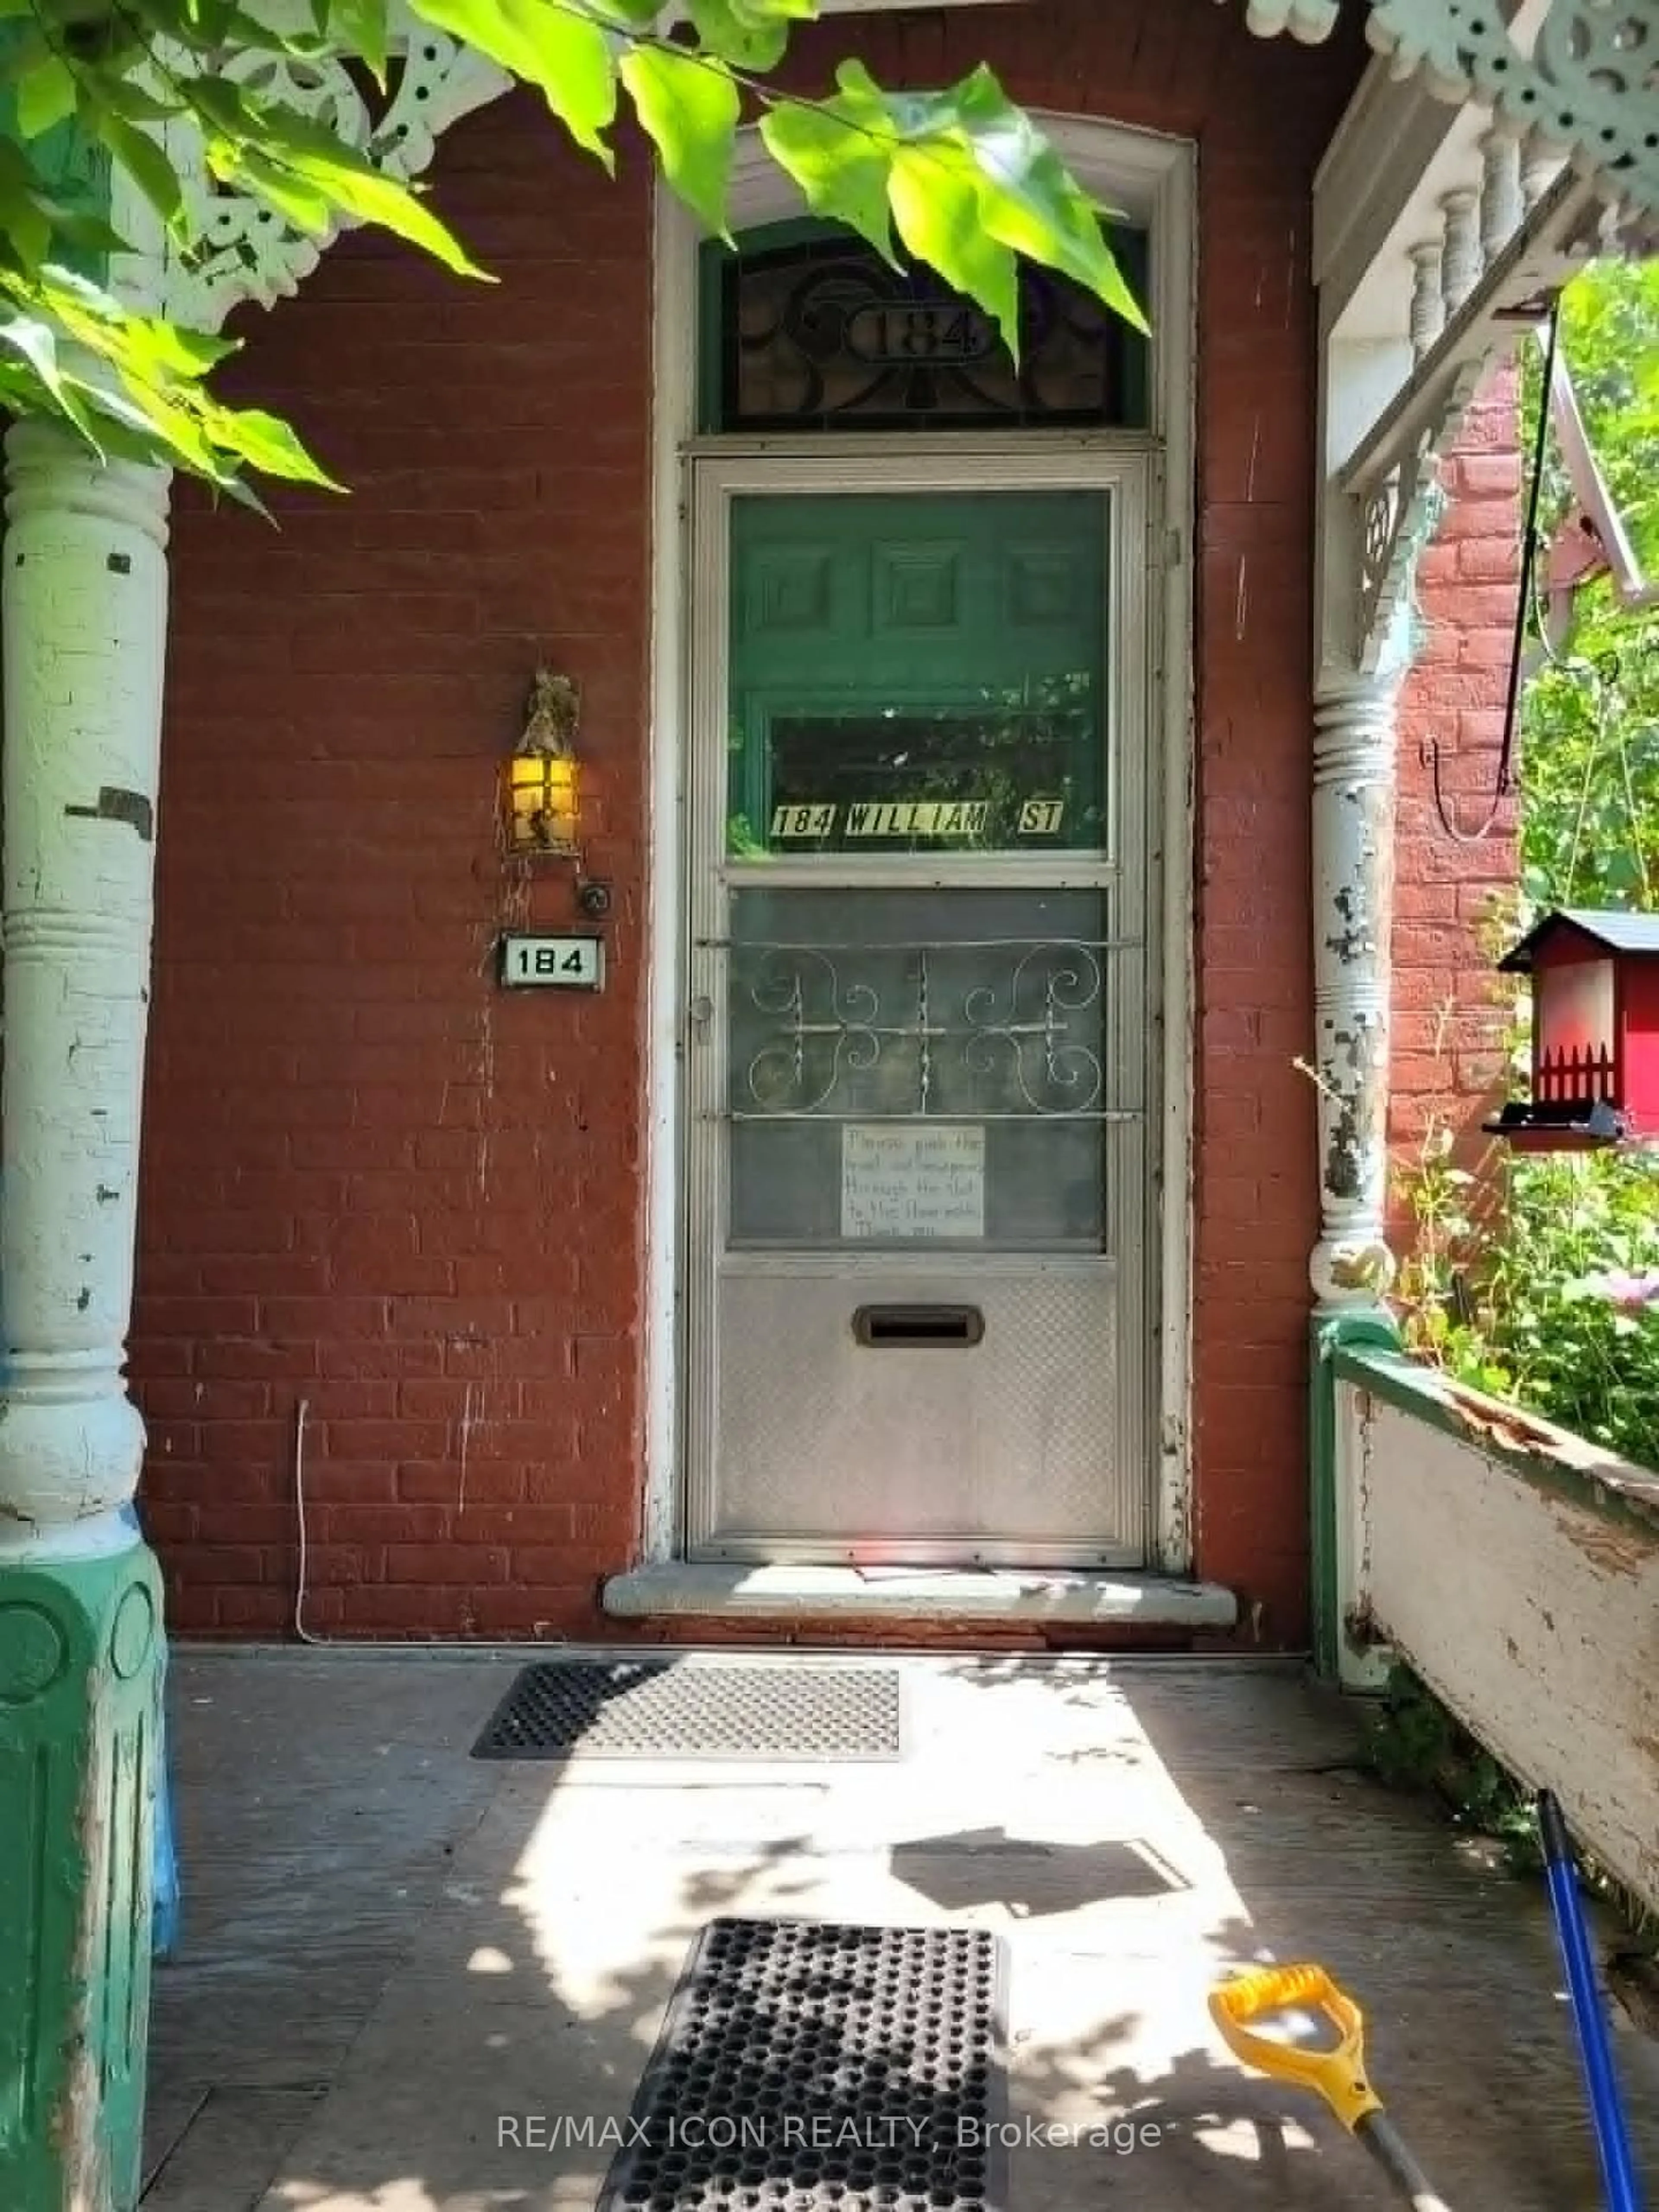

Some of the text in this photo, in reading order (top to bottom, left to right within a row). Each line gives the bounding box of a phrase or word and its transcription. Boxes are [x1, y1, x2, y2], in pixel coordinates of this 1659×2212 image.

[875, 309, 979, 358] 184
[778, 804, 1061, 832] 184 WILLIAM ST
[519, 948, 582, 974] 184
